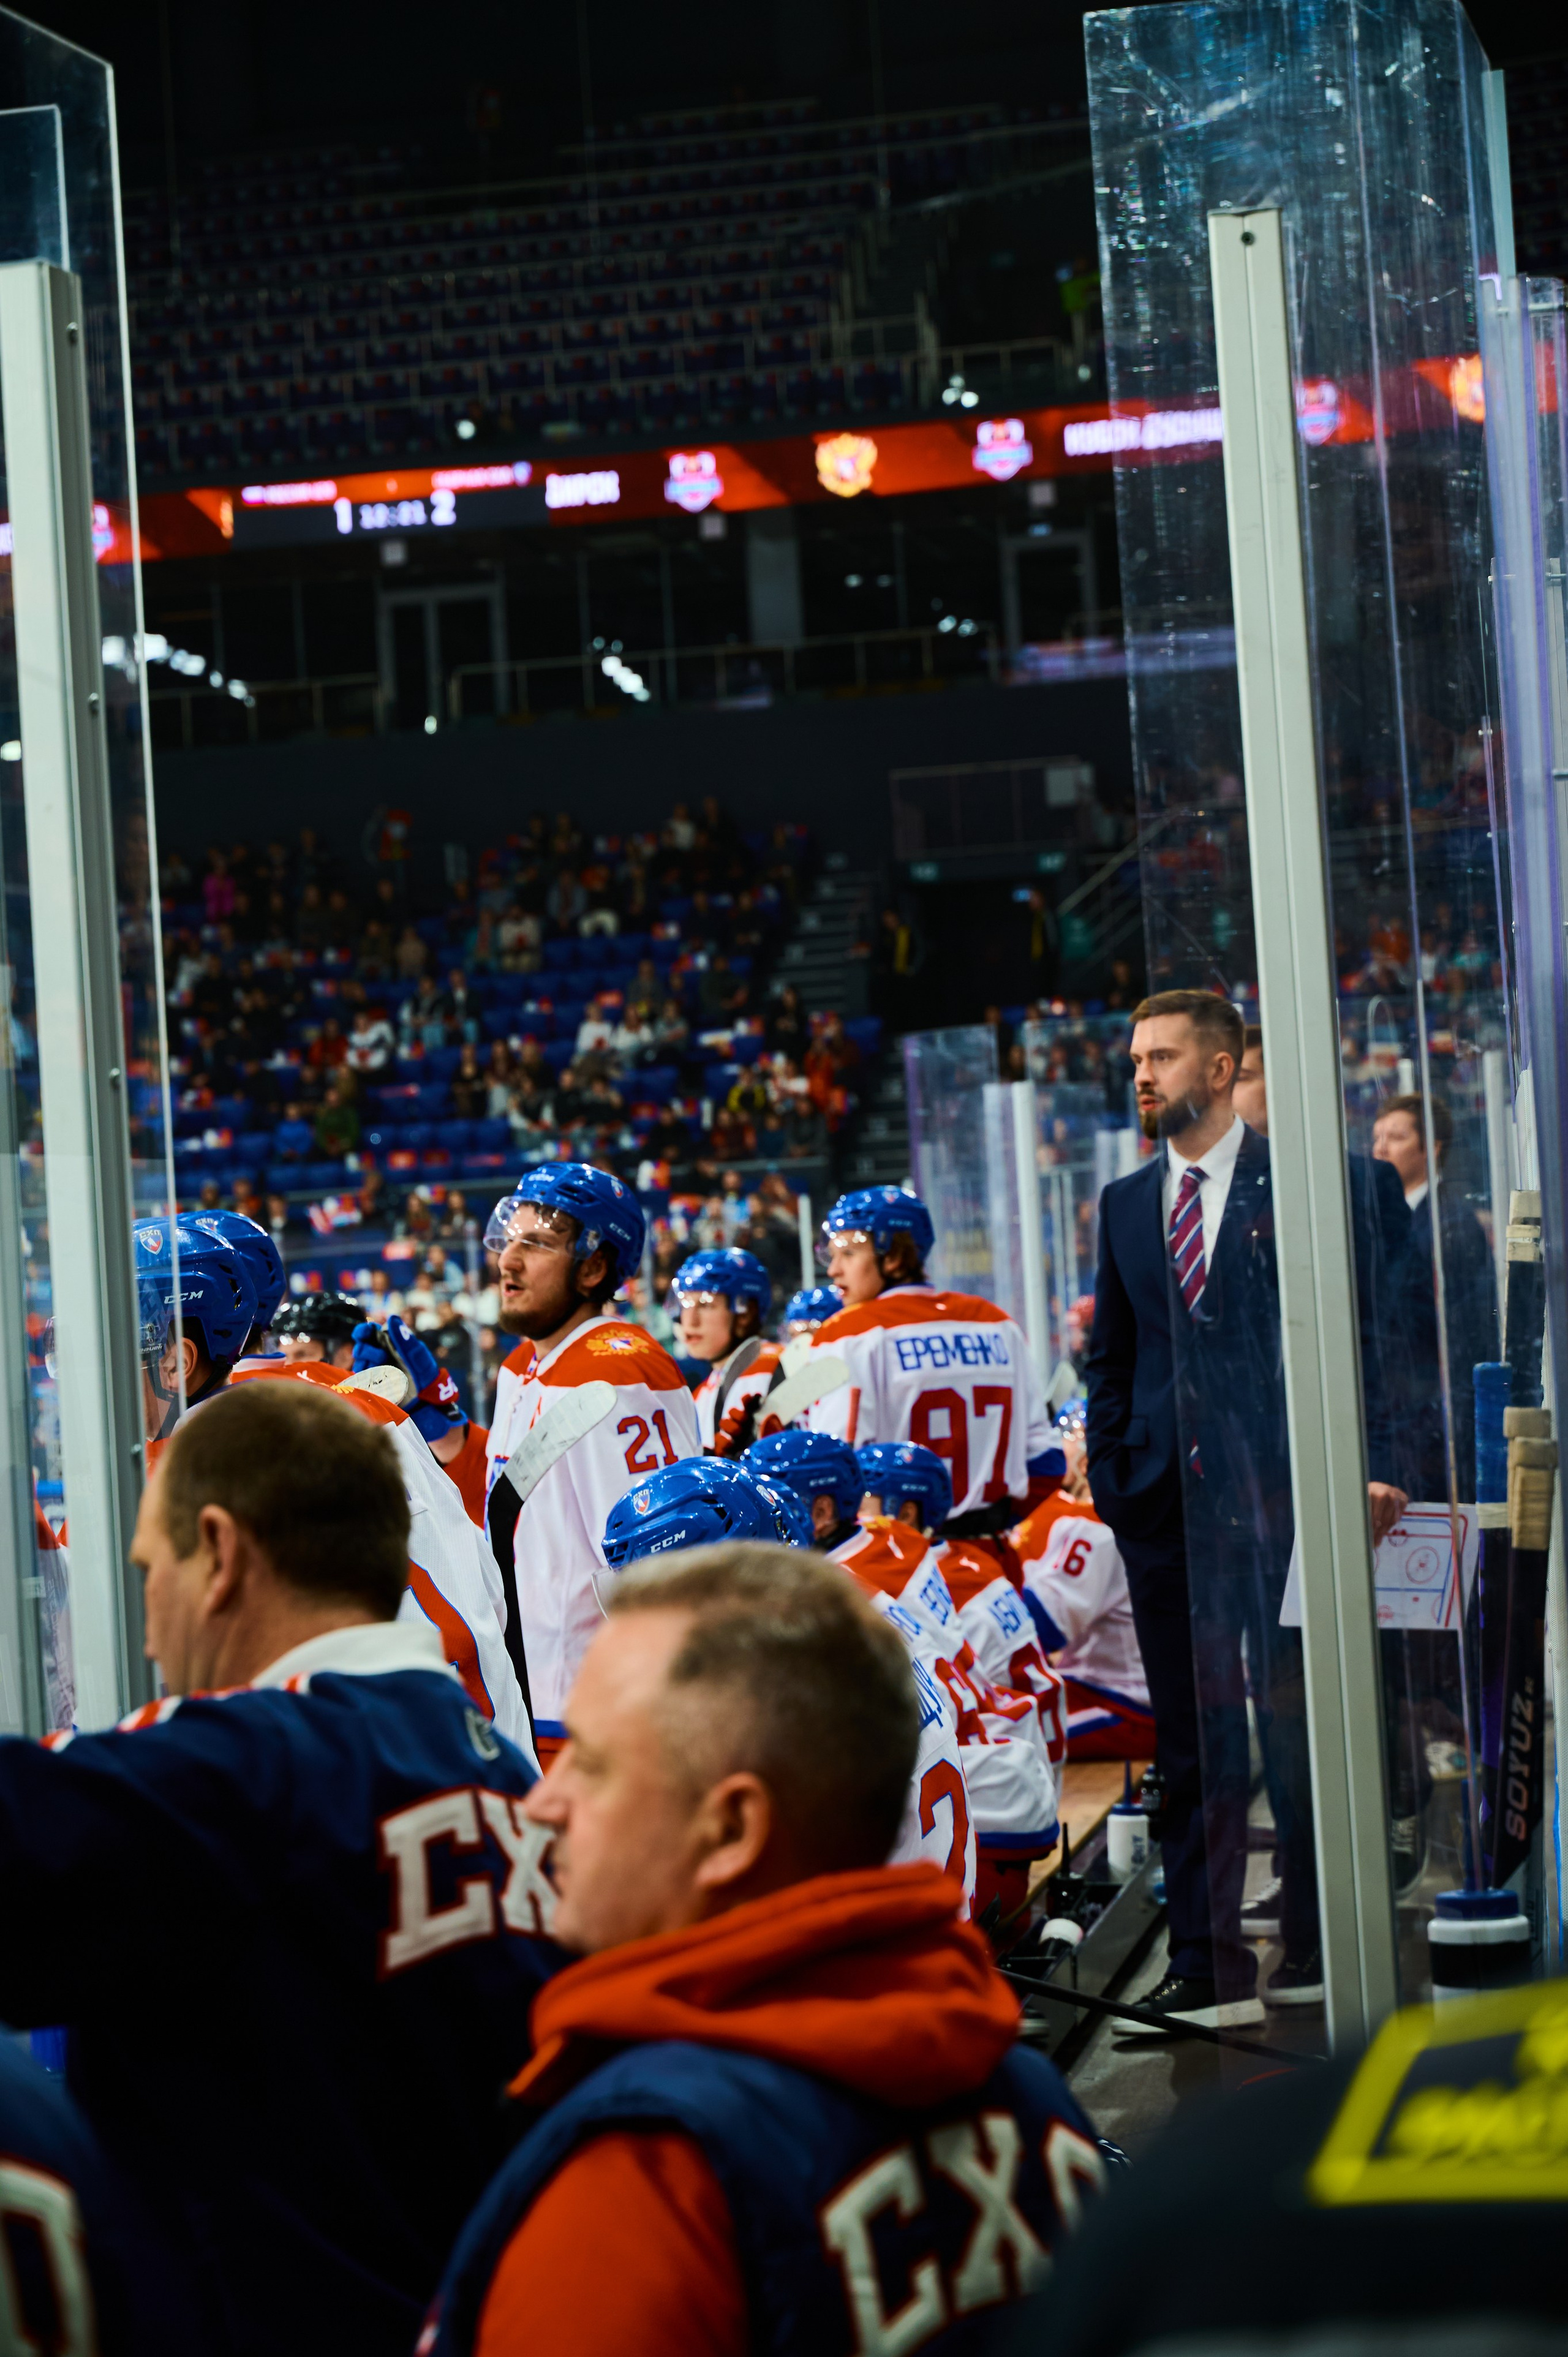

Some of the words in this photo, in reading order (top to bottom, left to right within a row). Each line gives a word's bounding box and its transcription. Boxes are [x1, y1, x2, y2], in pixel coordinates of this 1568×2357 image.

[431, 488, 456, 526] 2
[164, 1290, 203, 1305] CCM
[617, 1409, 679, 1475] 21
[908, 1385, 1012, 1507] 97
[650, 1529, 686, 1554] CCM
[1505, 1691, 1534, 1841] SOYUZ
[375, 1784, 562, 1983] СХ
